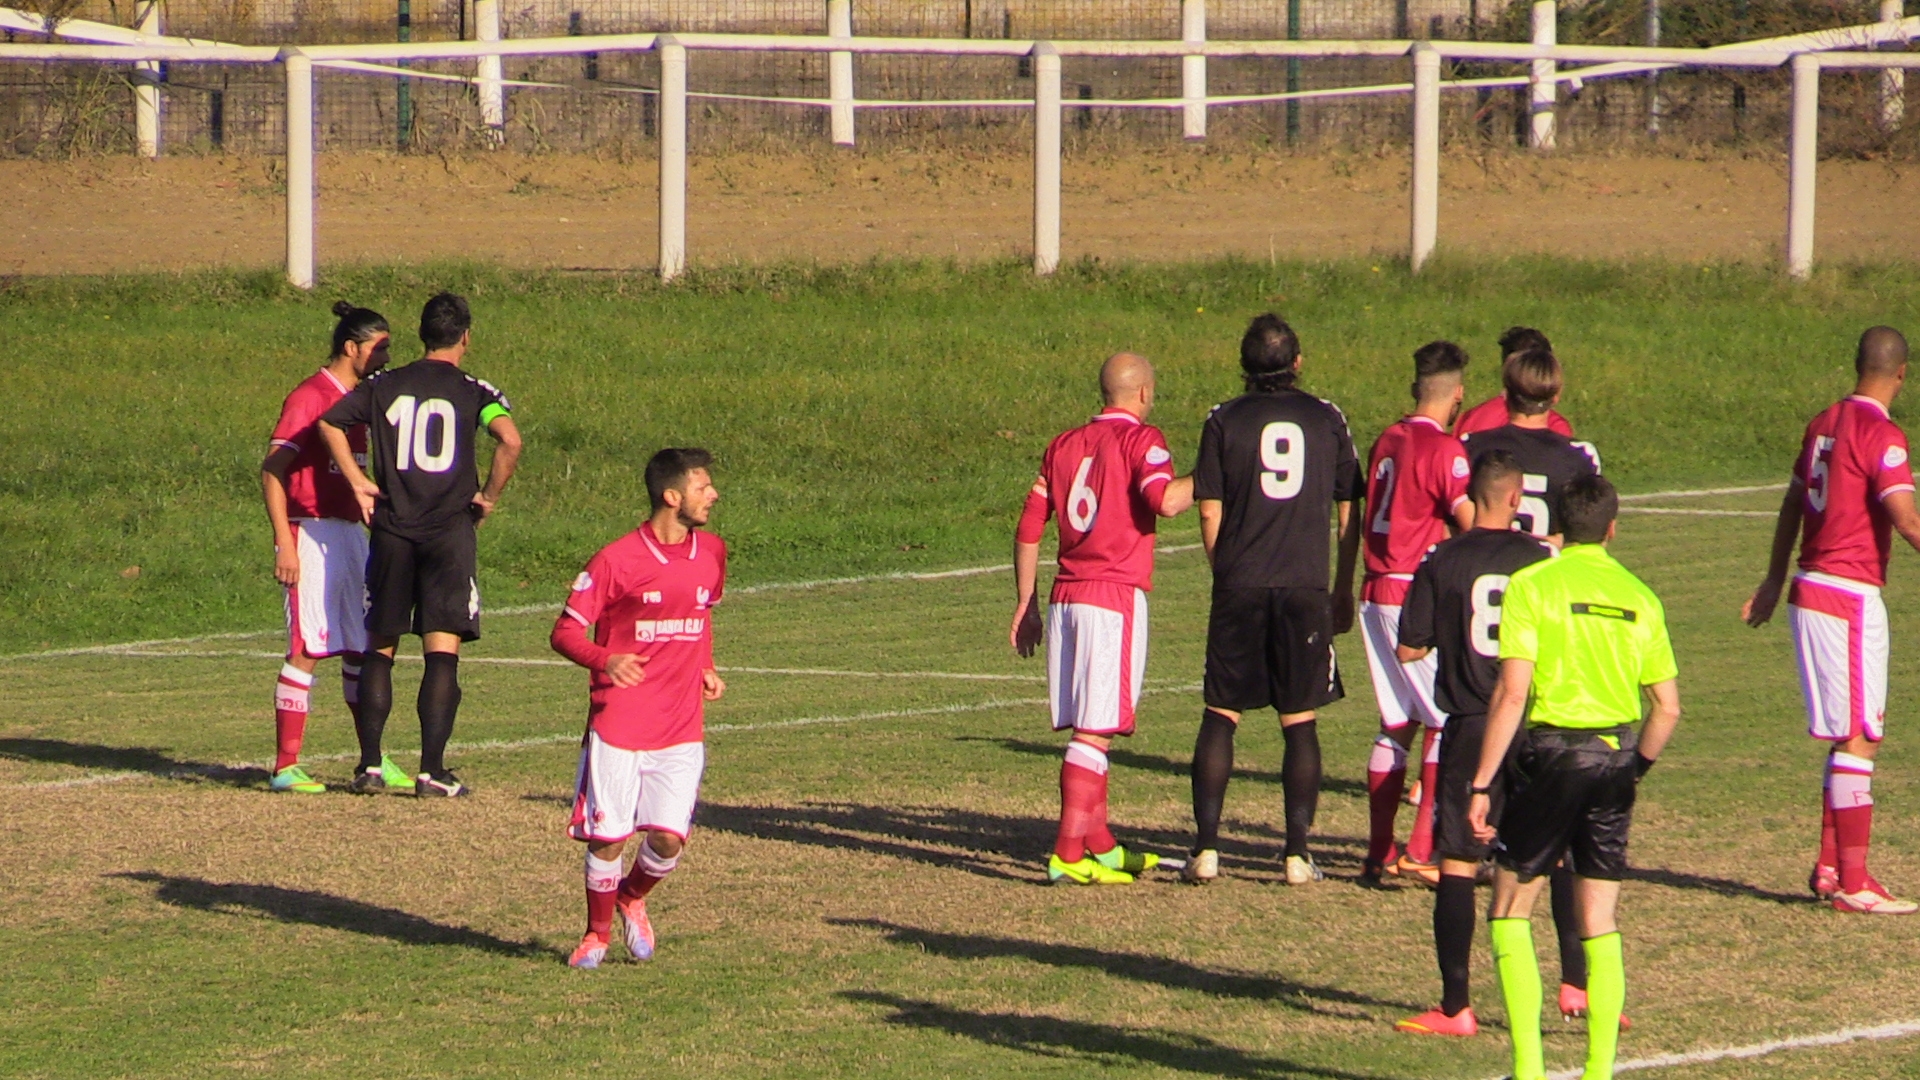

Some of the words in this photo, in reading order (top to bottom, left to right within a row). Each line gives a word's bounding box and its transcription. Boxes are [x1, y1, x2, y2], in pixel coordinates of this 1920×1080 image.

[385, 395, 456, 472] 10
[1260, 421, 1306, 499] 9
[1067, 456, 1098, 533] 6
[1371, 457, 1395, 534] 2
[1808, 435, 1836, 512] 5
[1470, 573, 1511, 656] 8
